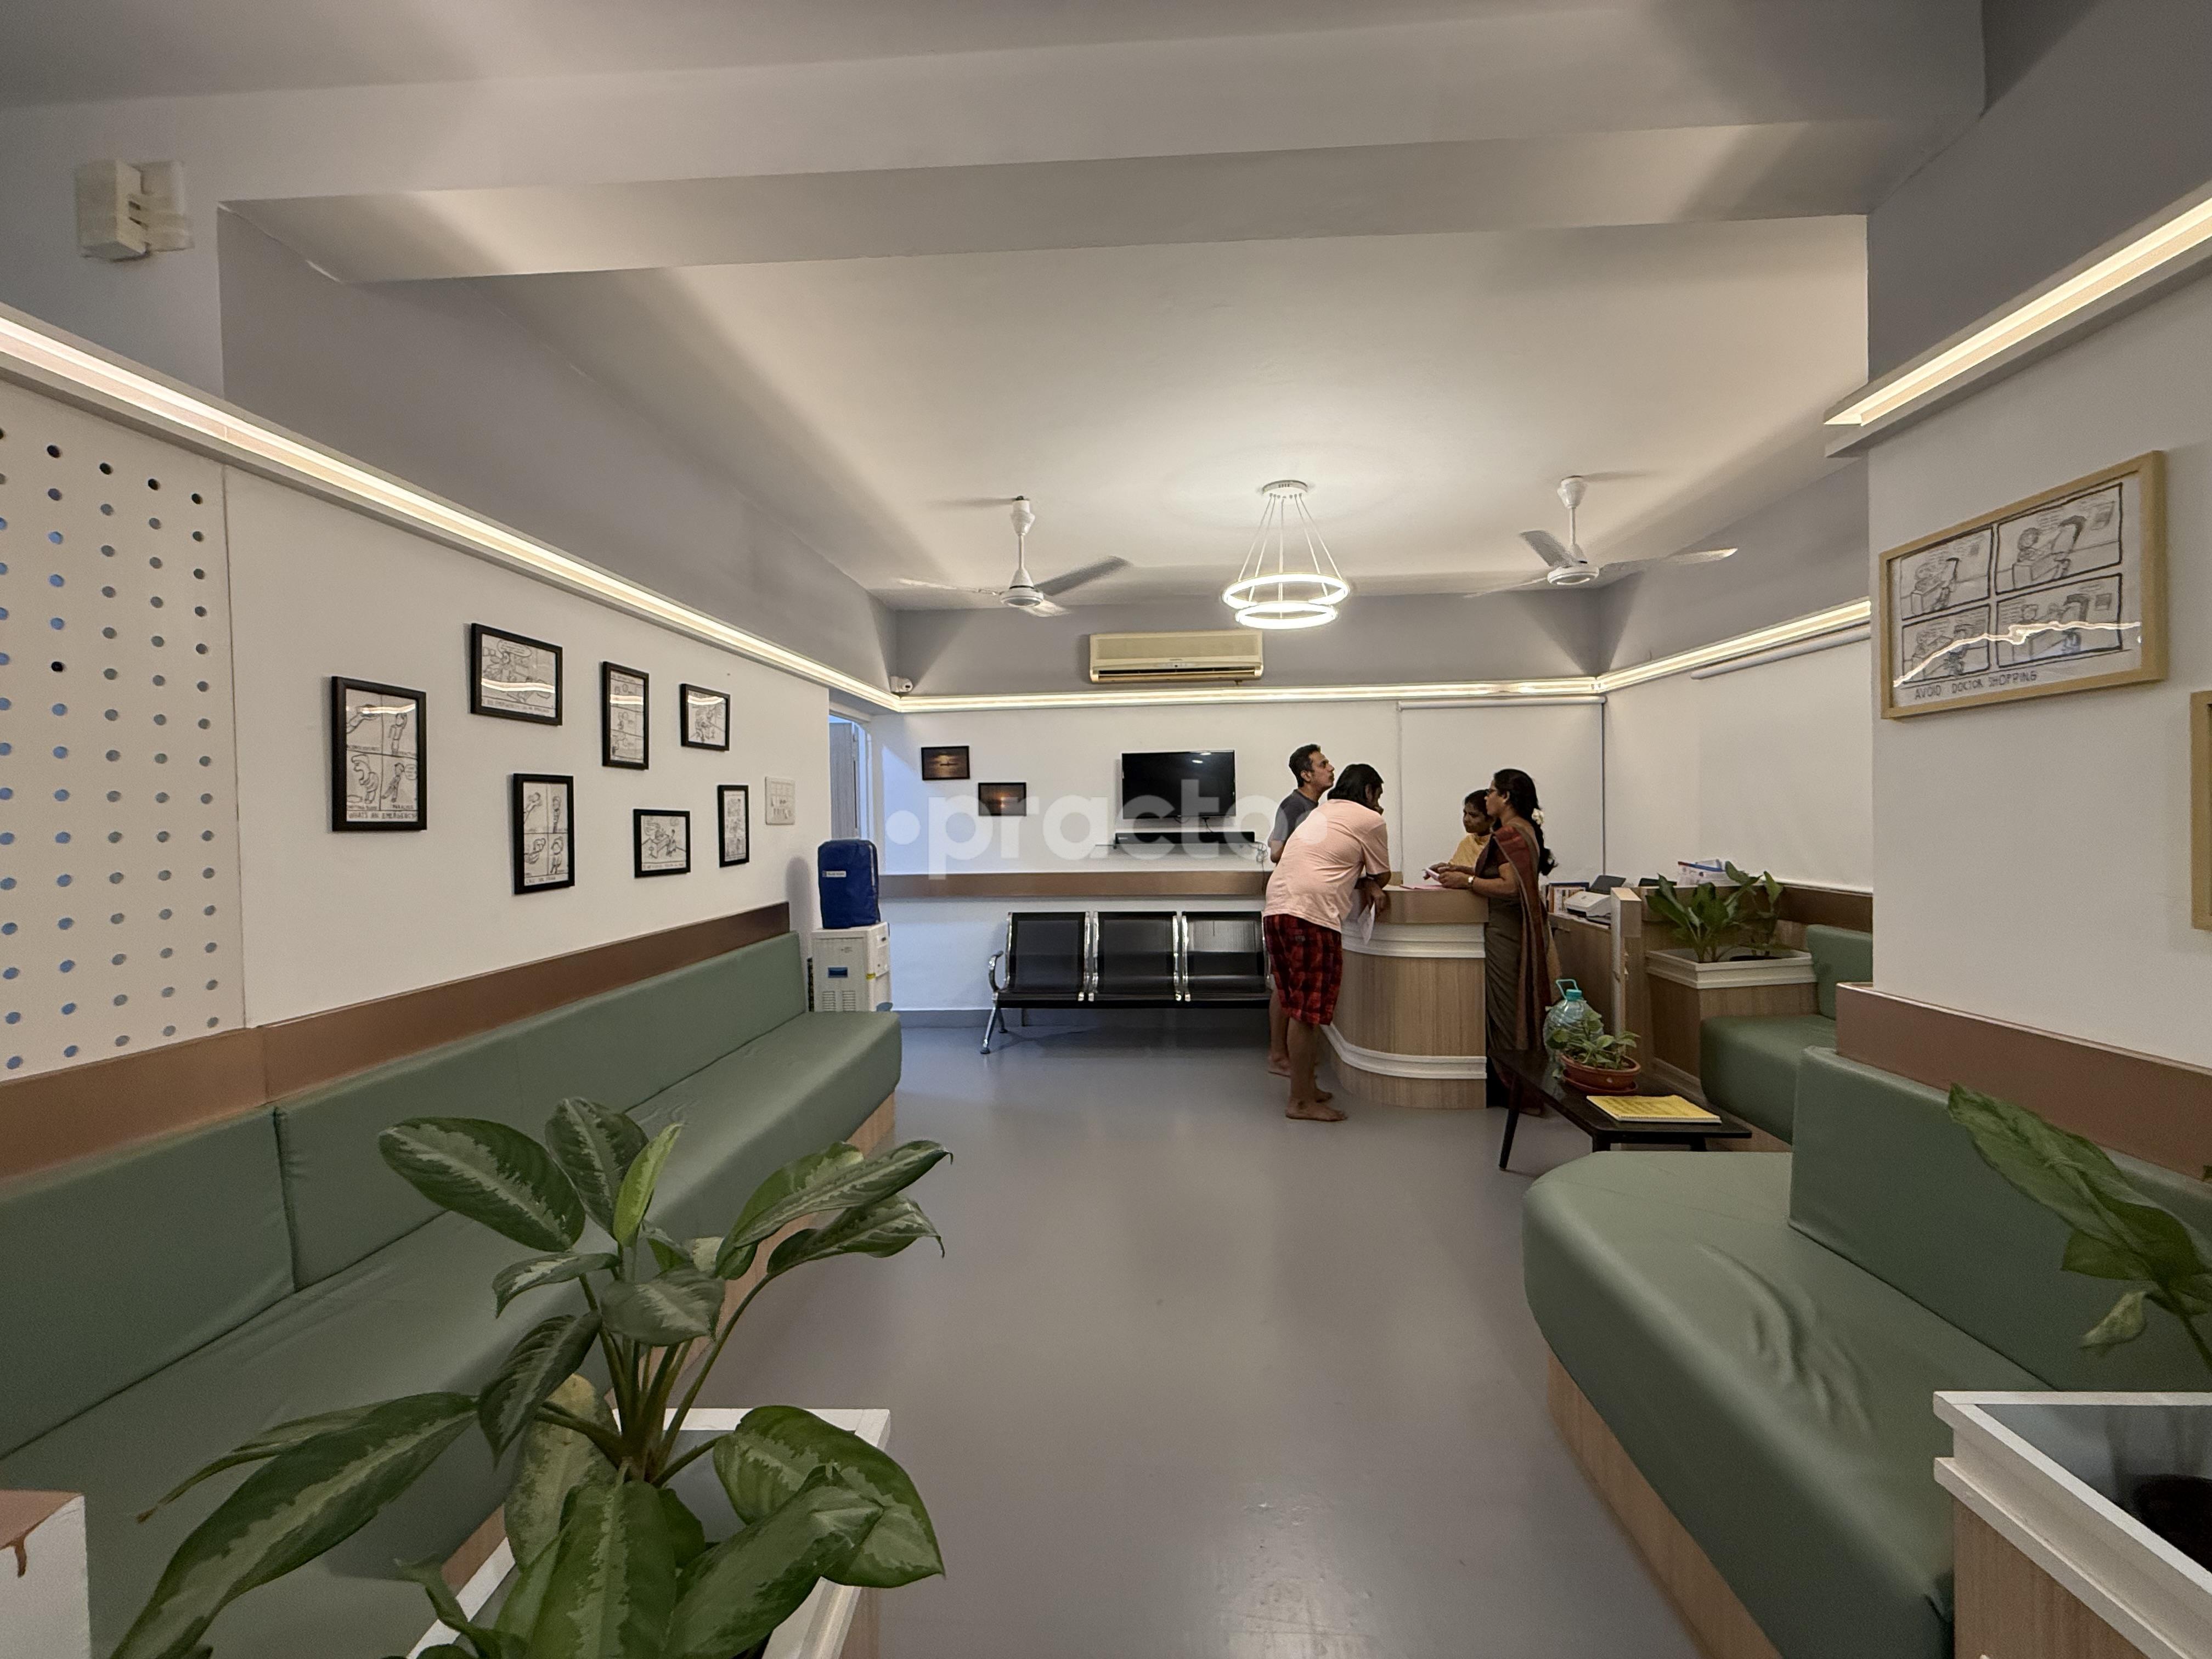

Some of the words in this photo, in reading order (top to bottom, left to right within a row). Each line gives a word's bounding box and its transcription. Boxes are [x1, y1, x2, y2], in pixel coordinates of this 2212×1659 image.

[1915, 685, 1942, 699] AVOID
[1951, 679, 1983, 693] DOCTOR
[1988, 670, 2037, 686] SHOPPING
